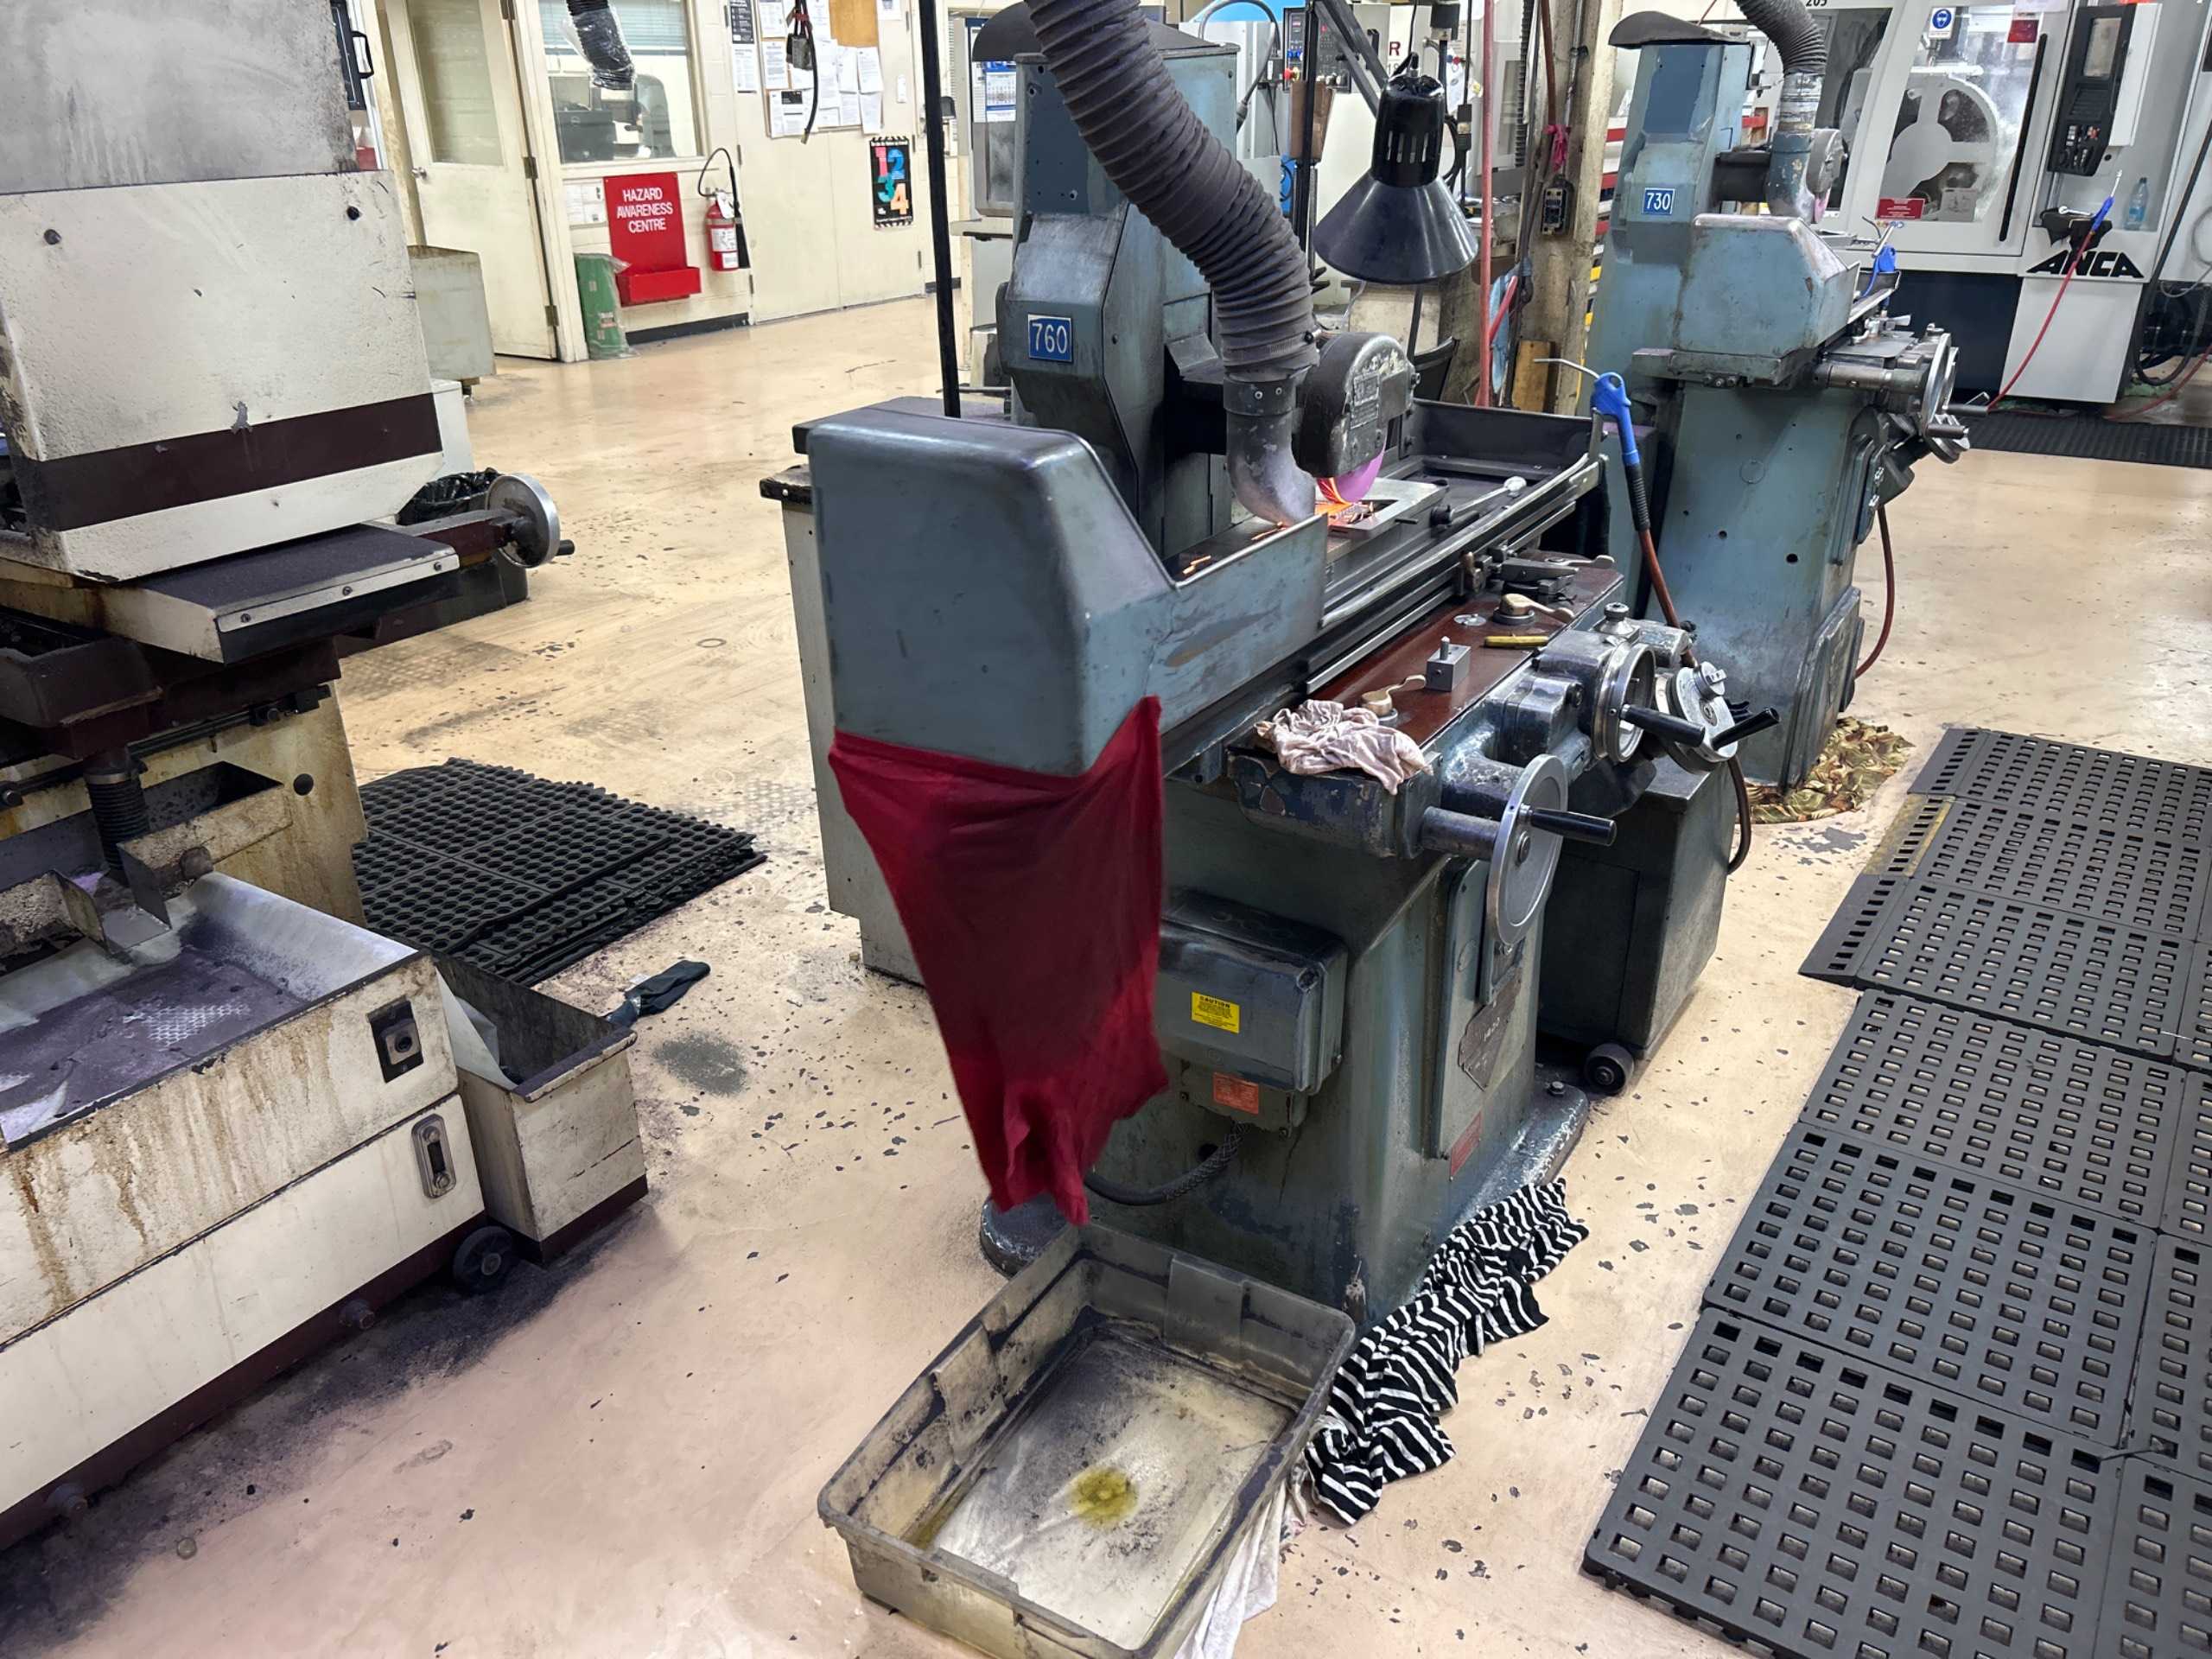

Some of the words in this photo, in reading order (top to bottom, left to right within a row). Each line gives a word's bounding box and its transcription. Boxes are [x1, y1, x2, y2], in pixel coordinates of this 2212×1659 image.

[887, 148, 906, 180] 2
[622, 187, 663, 202] HAZARD
[890, 182, 909, 214] 4
[1646, 192, 1671, 210] 730
[616, 202, 674, 219] AWARENESS
[628, 218, 667, 233] CENTRE
[2026, 249, 2145, 278] ANCA
[1032, 322, 1068, 354] 760
